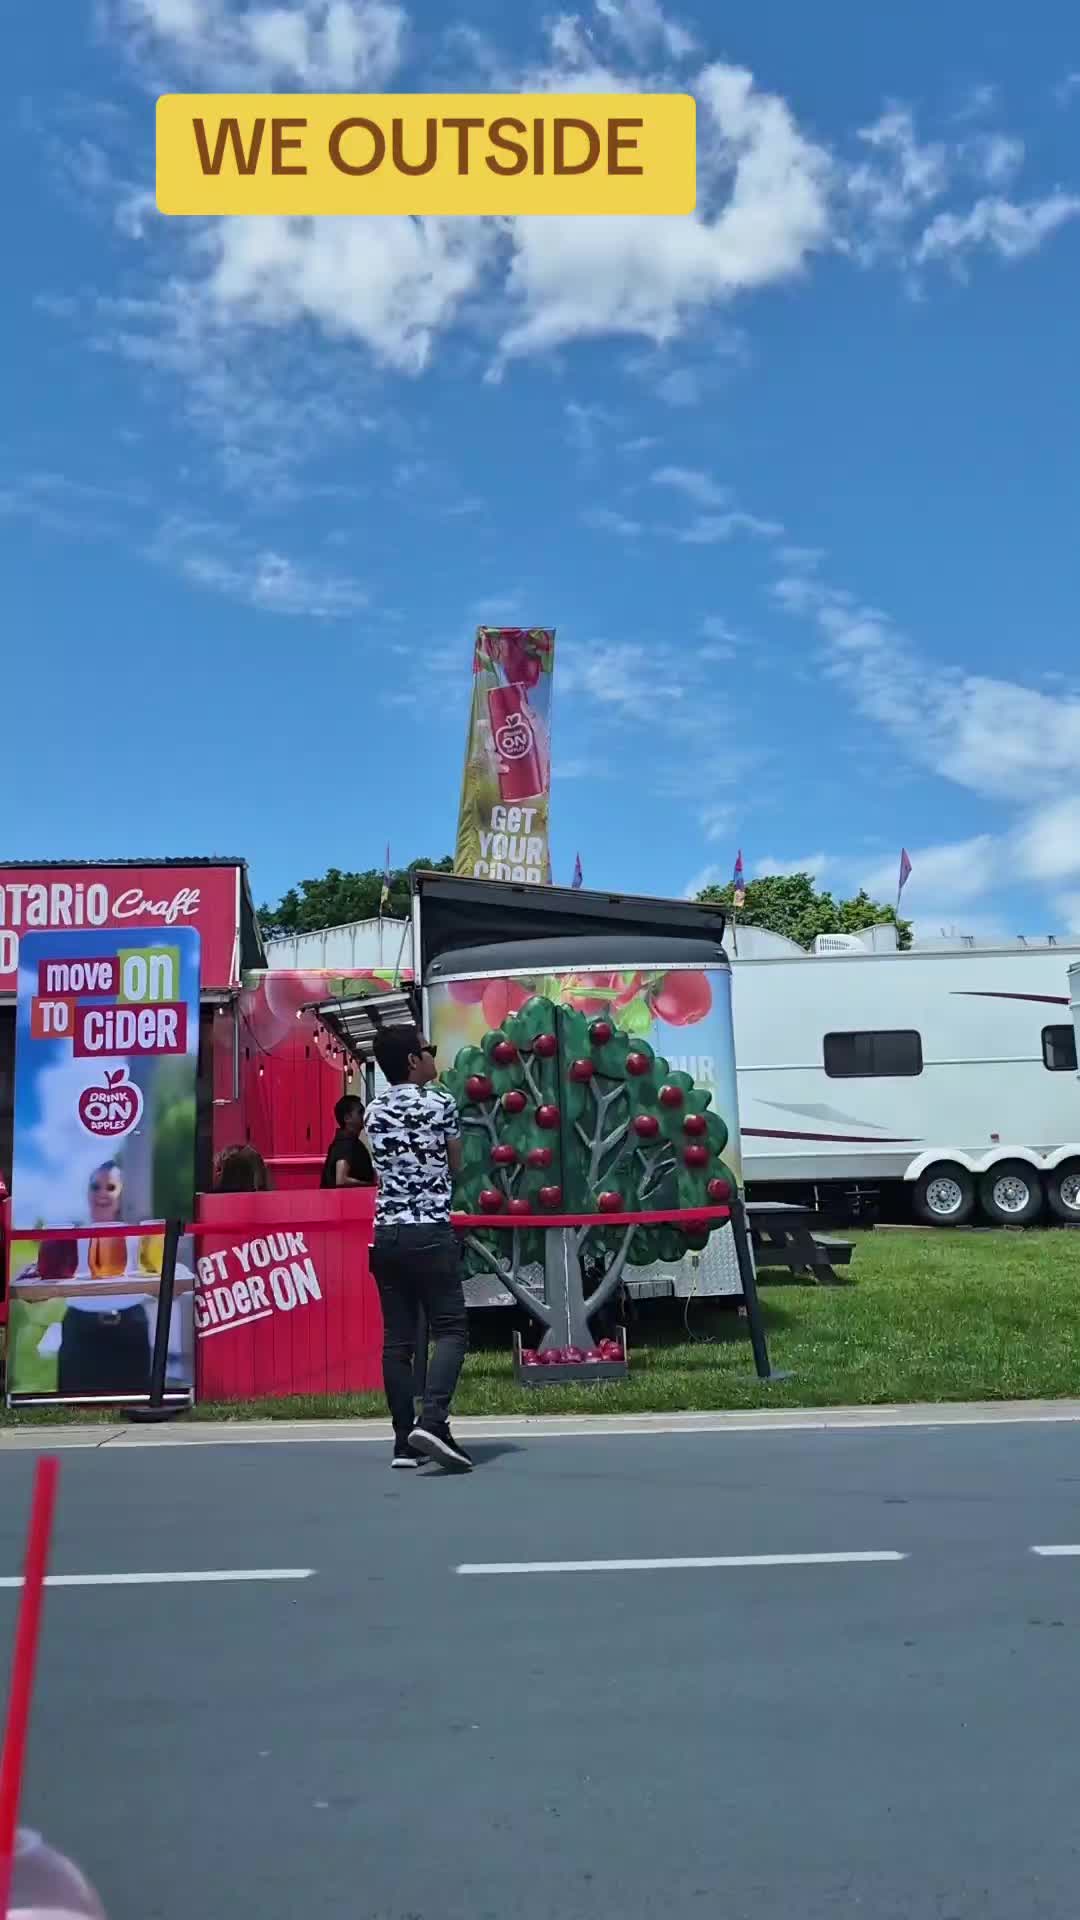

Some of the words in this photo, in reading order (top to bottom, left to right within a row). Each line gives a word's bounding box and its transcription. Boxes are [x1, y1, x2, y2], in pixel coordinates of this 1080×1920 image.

[502, 734, 528, 749] ON
[479, 830, 543, 865] YOUR
[111, 887, 201, 925] Craft
[46, 962, 113, 993] move
[39, 1001, 69, 1033] TO
[84, 1101, 132, 1121] ON
[89, 1092, 129, 1102] DRINK
[91, 1120, 126, 1130] APPLES
[195, 1250, 228, 1287] eT
[231, 1231, 309, 1273] YOUR
[269, 1257, 323, 1312] ON
